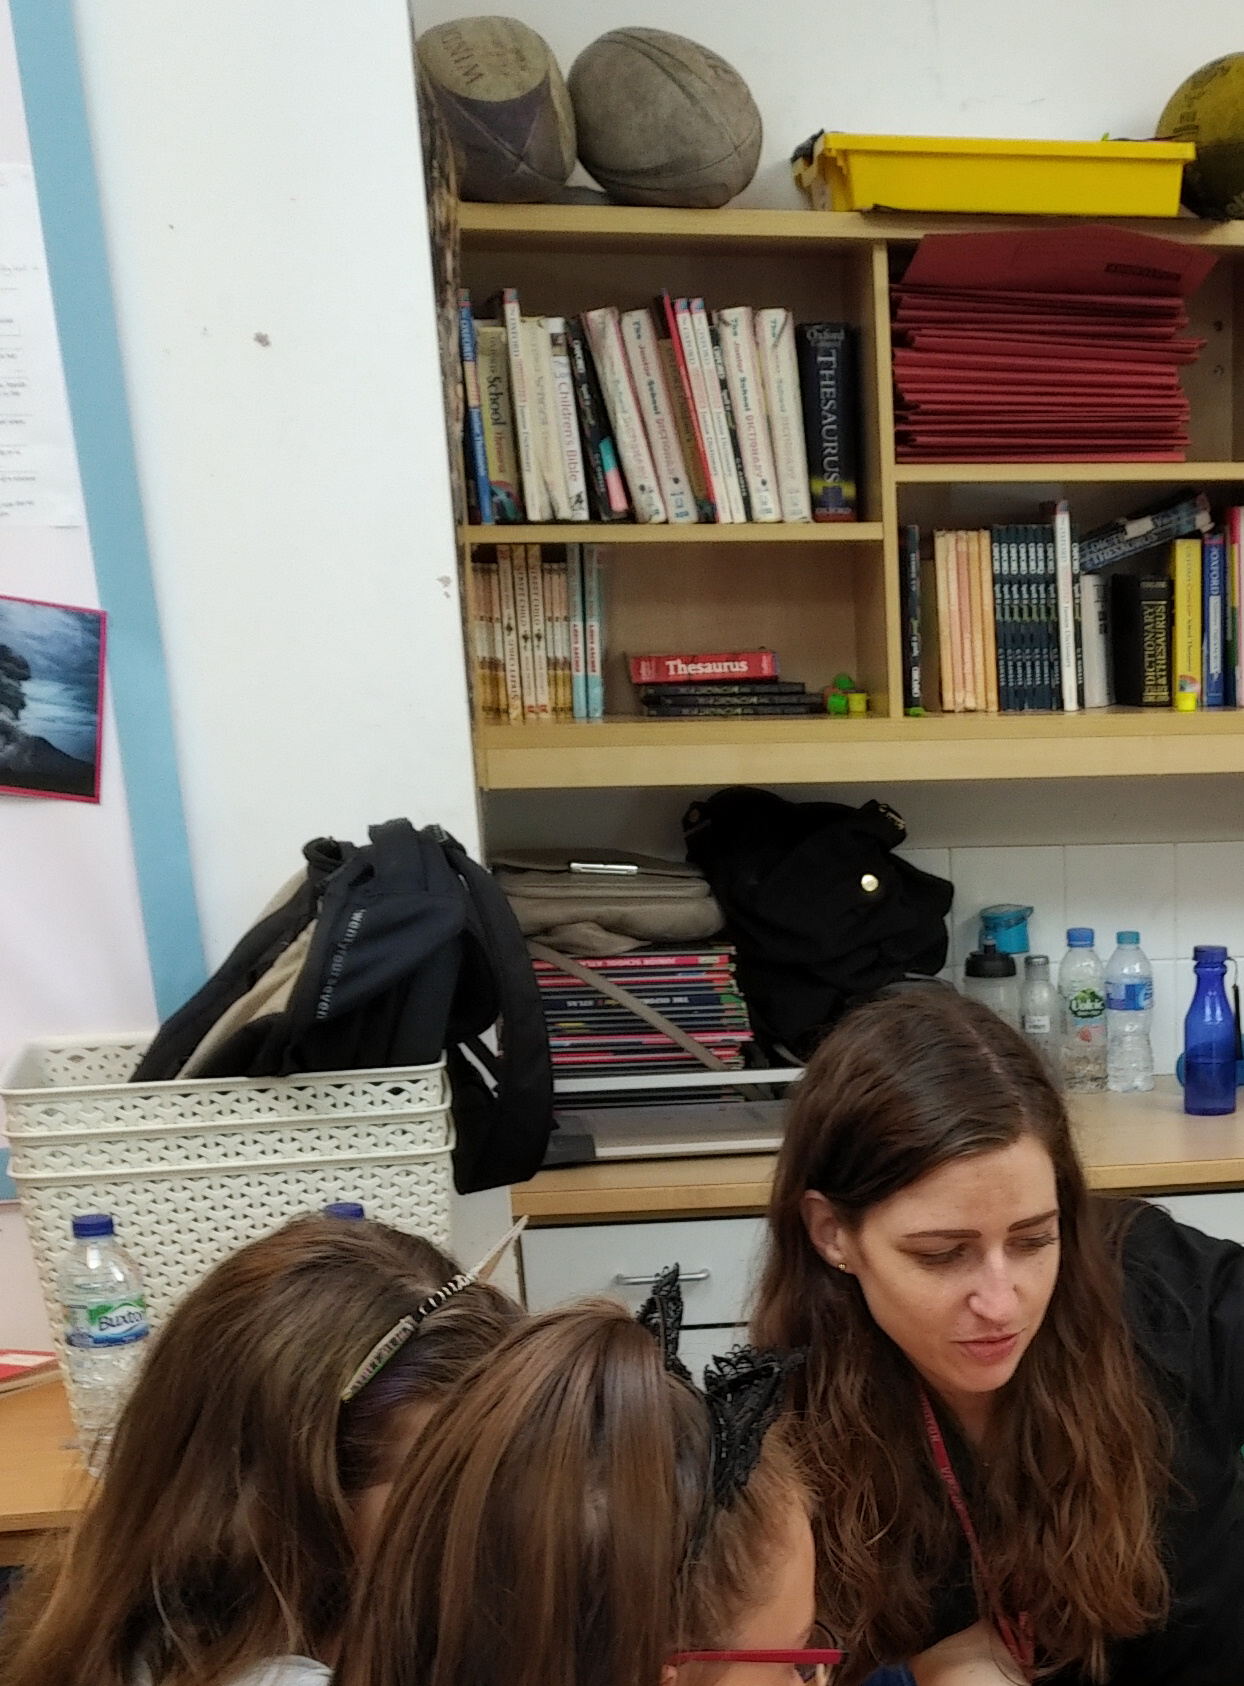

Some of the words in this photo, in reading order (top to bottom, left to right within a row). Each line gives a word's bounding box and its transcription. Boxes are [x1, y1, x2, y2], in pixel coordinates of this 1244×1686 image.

[486, 375, 506, 426] School
[556, 381, 575, 445] Children's
[739, 376, 751, 411] School
[817, 348, 840, 483] THESAURUS
[565, 449, 580, 482] Bible
[744, 414, 762, 478] DICTIONARY
[1209, 552, 1217, 593] OXFORD
[665, 655, 748, 675] Thesaurus
[1142, 604, 1156, 687] DICTIONARY
